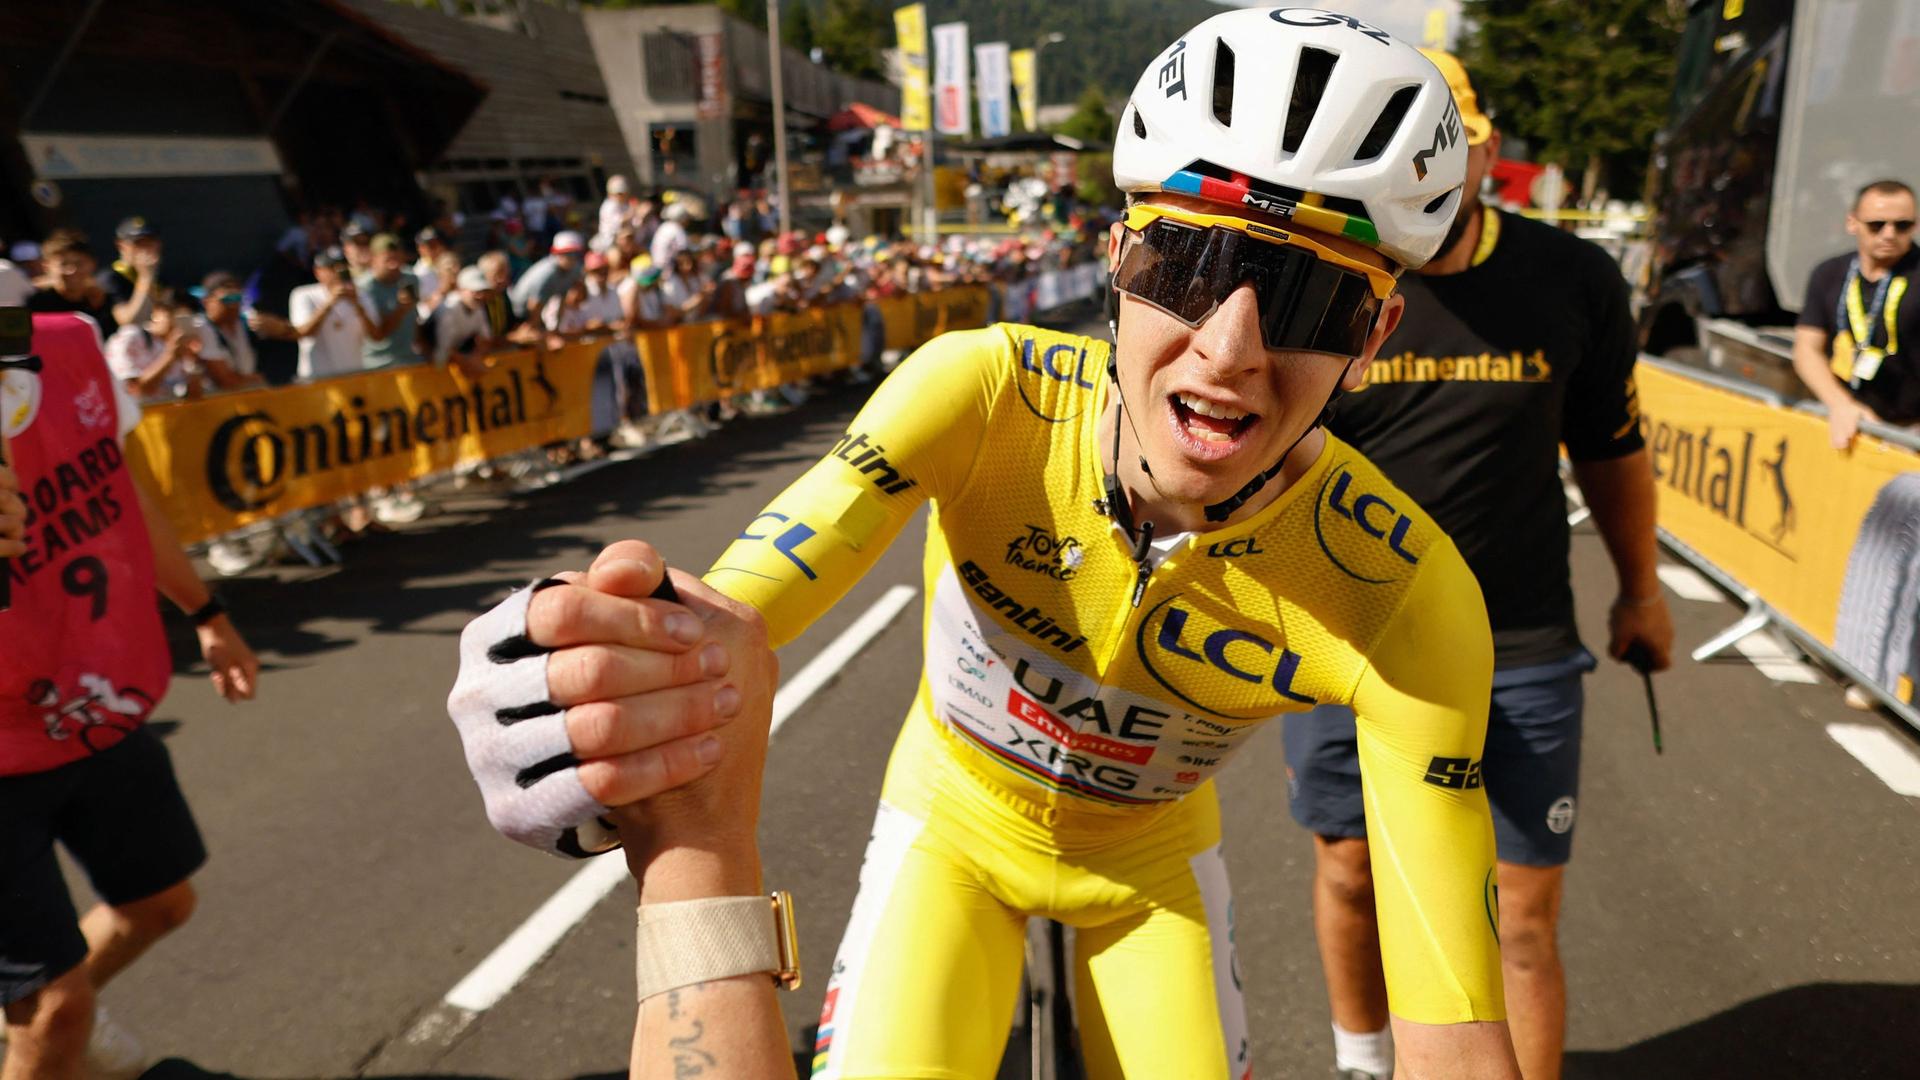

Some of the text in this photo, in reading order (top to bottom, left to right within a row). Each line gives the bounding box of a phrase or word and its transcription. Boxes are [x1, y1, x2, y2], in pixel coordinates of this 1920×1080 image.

[1021, 338, 1094, 390] LCL
[206, 368, 528, 512] Continental
[737, 512, 817, 580] CL
[1207, 537, 1263, 558] LCL
[1328, 471, 1419, 565] LCL
[62, 555, 109, 622] 9
[958, 560, 1088, 652] Santini
[1157, 607, 1318, 705] LCL
[1013, 657, 1171, 740] UAE
[1007, 722, 1139, 791] XRG
